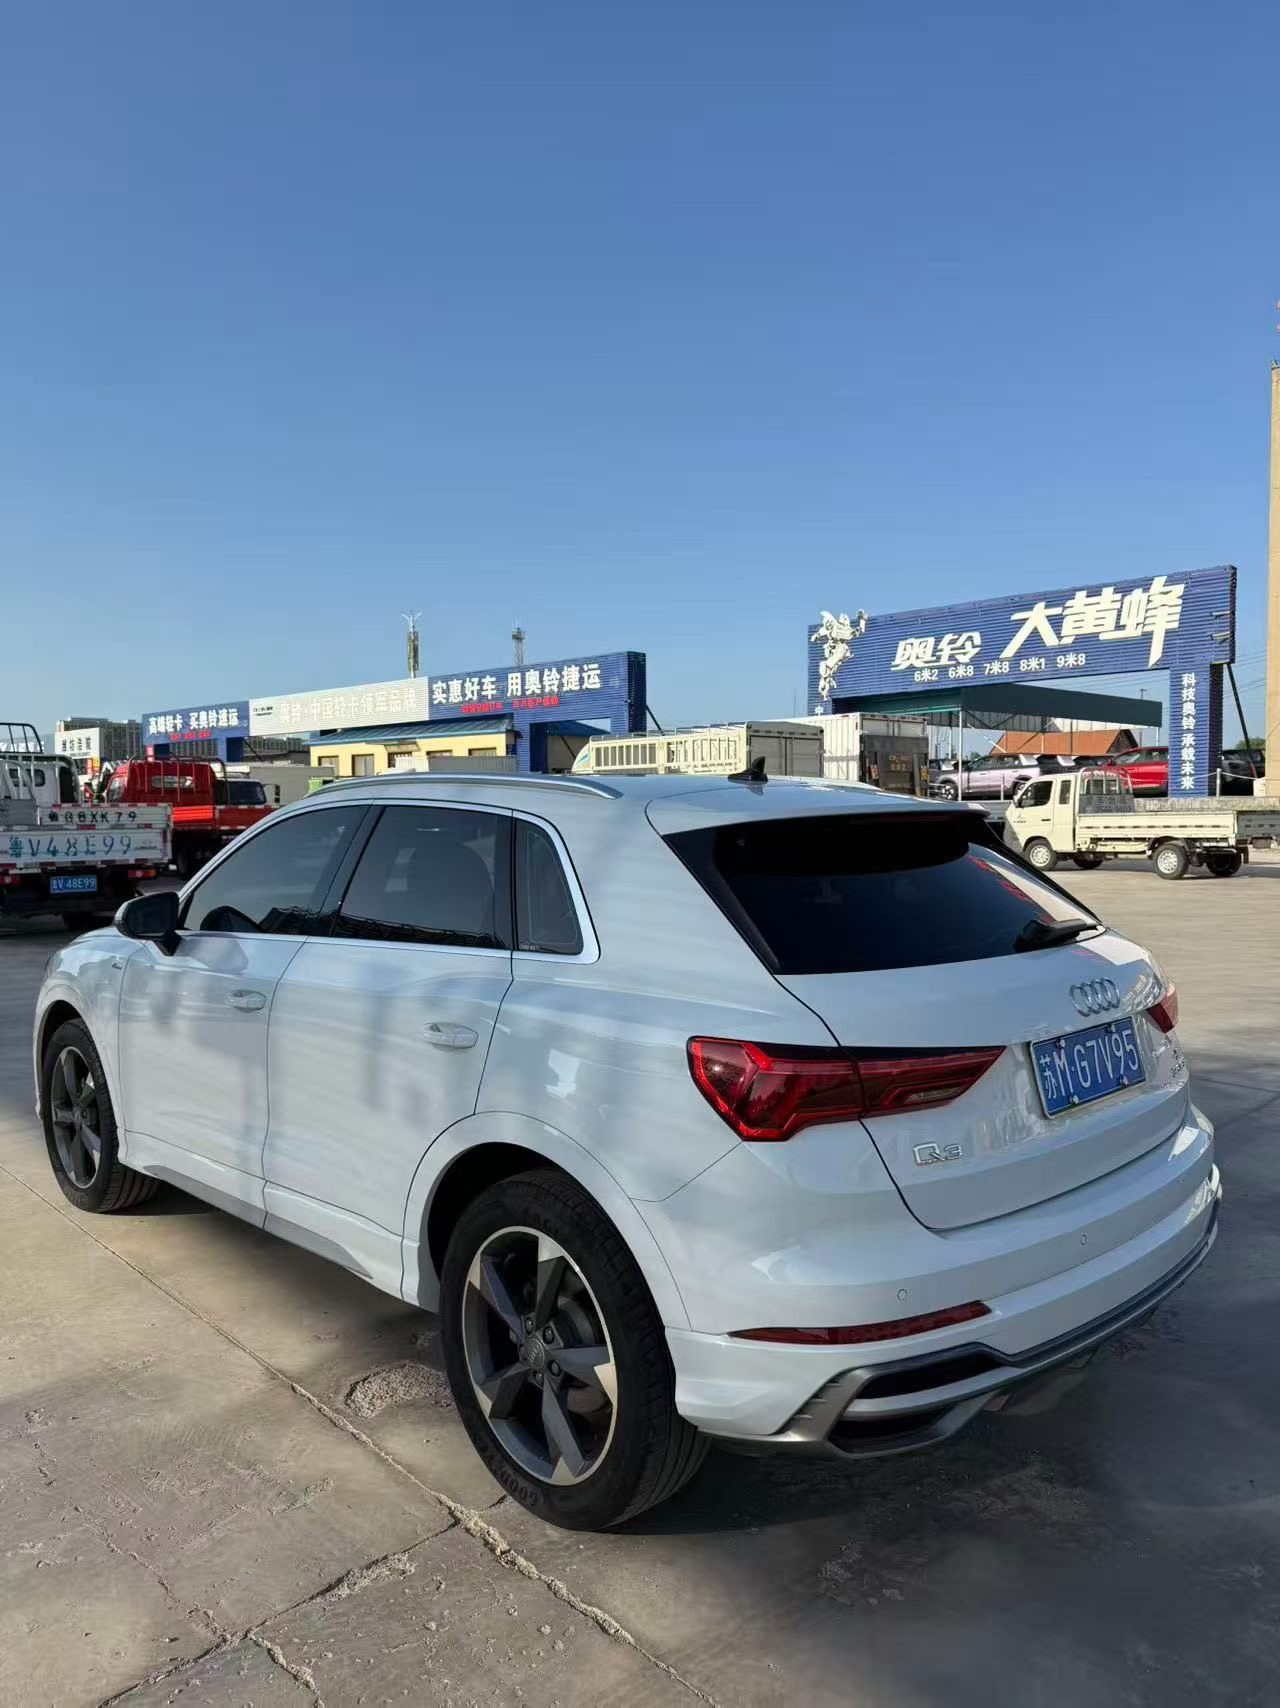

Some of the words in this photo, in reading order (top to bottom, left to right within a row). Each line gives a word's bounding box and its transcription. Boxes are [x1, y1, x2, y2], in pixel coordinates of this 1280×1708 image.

[891, 631, 982, 670] 奥铃
[1000, 576, 1185, 668] 大黄蜂
[432, 675, 497, 704] 实惠好车
[506, 663, 601, 697] 用奥铃捷运
[914, 669, 938, 682] 6米2
[949, 666, 974, 679] 6米8
[984, 661, 1009, 675] 7米8
[1020, 658, 1046, 671] 8米1
[1057, 653, 1086, 668] 9米8
[1181, 672, 1196, 730] 科技奥铃
[1180, 733, 1196, 790] 承载未来
[912, 1142, 963, 1166] Q3
